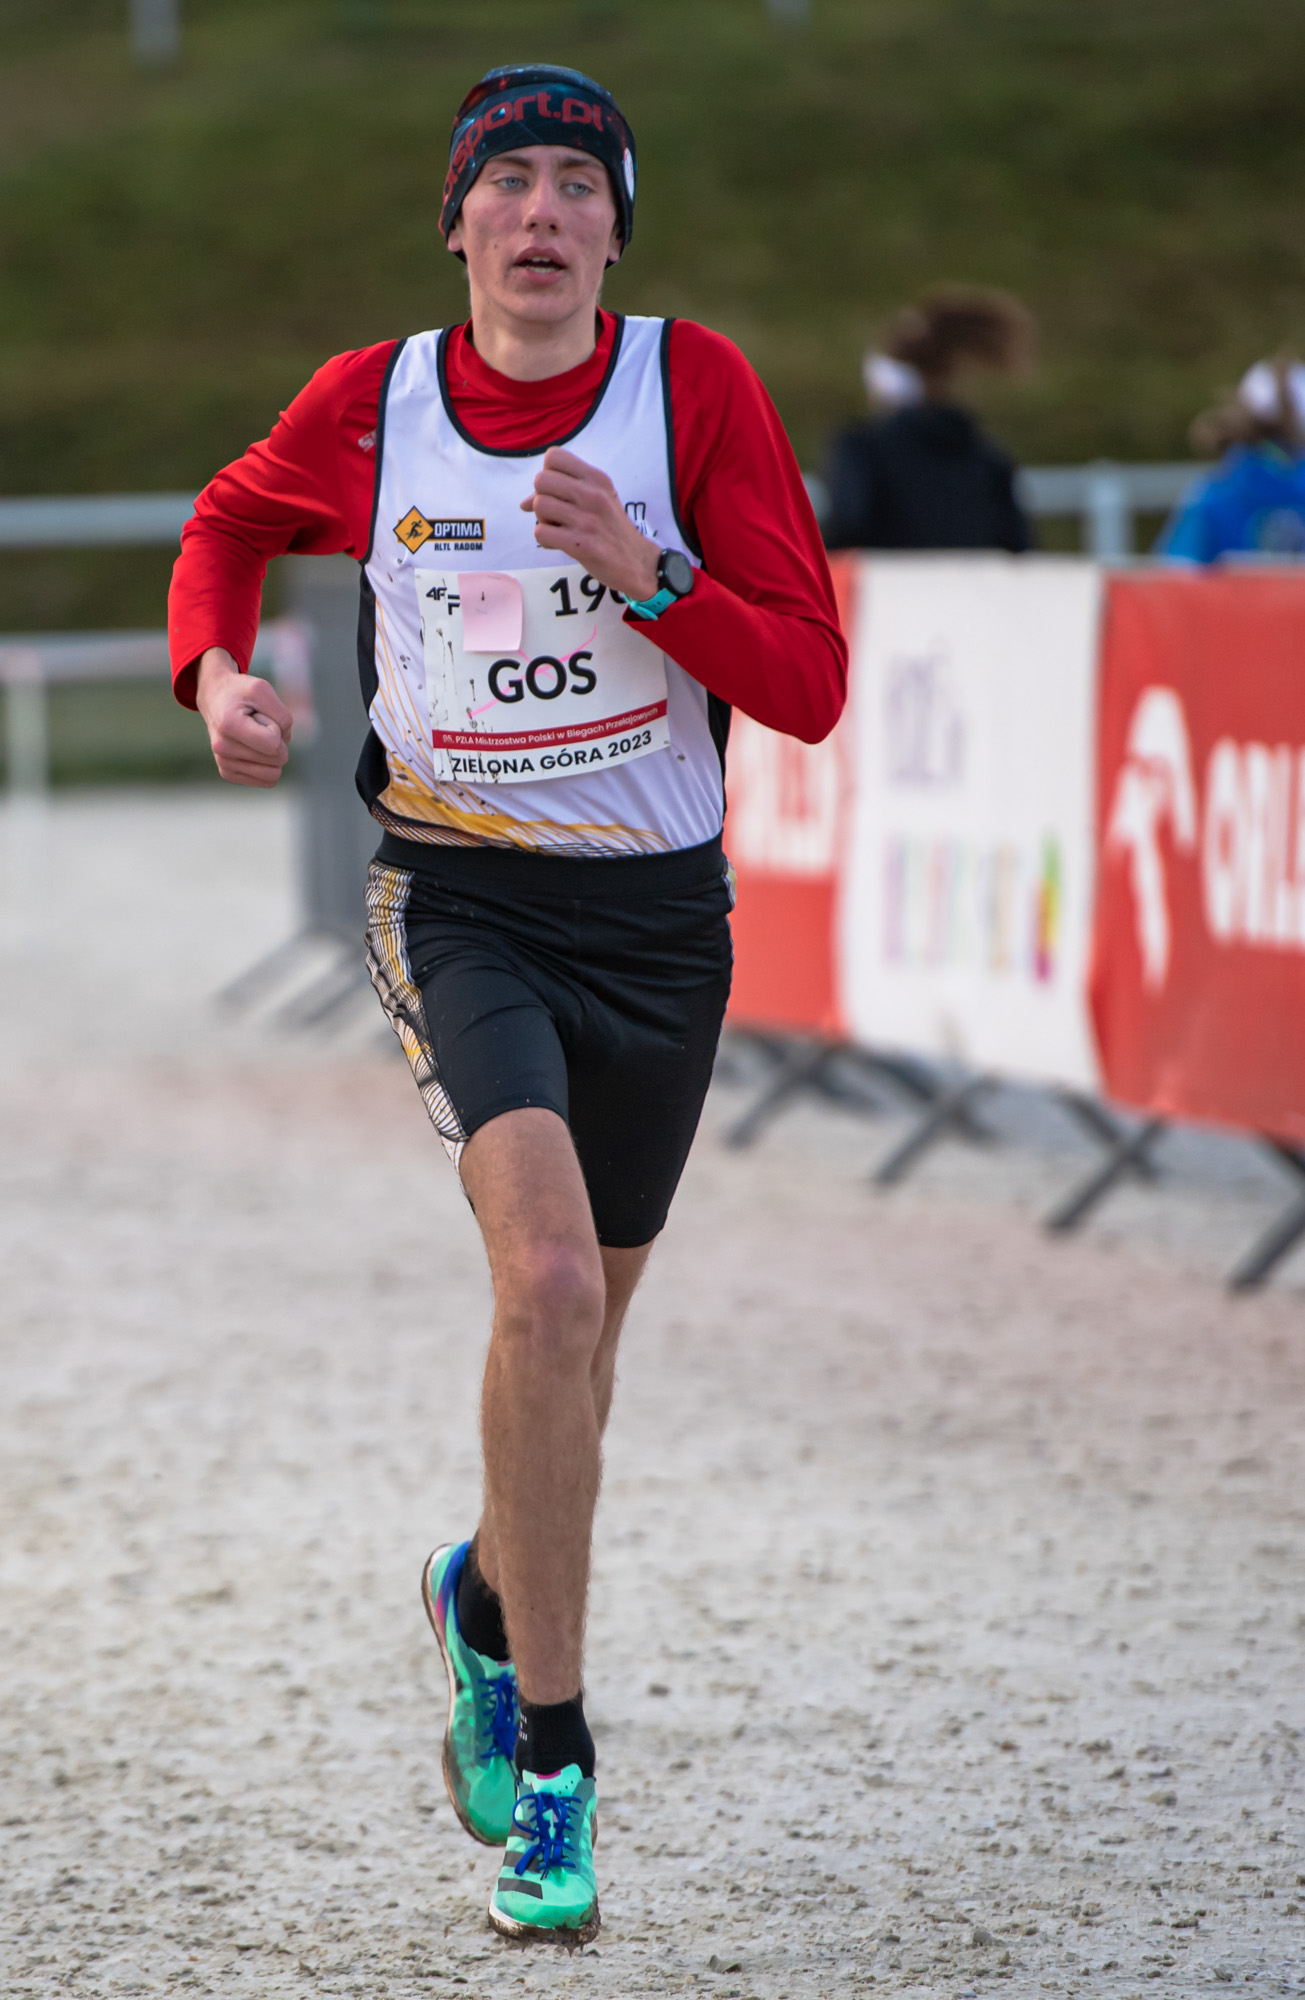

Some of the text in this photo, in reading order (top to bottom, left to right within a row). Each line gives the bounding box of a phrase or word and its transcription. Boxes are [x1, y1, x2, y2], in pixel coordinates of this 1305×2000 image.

[434, 522, 482, 537] OPTIMA
[454, 542, 483, 551] RADOM
[487, 650, 598, 704] GOS
[455, 735, 474, 745] PZLA
[475, 735, 527, 746] Mistrzostwa
[528, 731, 555, 742] Polski
[566, 724, 604, 738] Biegach
[451, 729, 652, 773] ZIELONA GÓRA 2023
